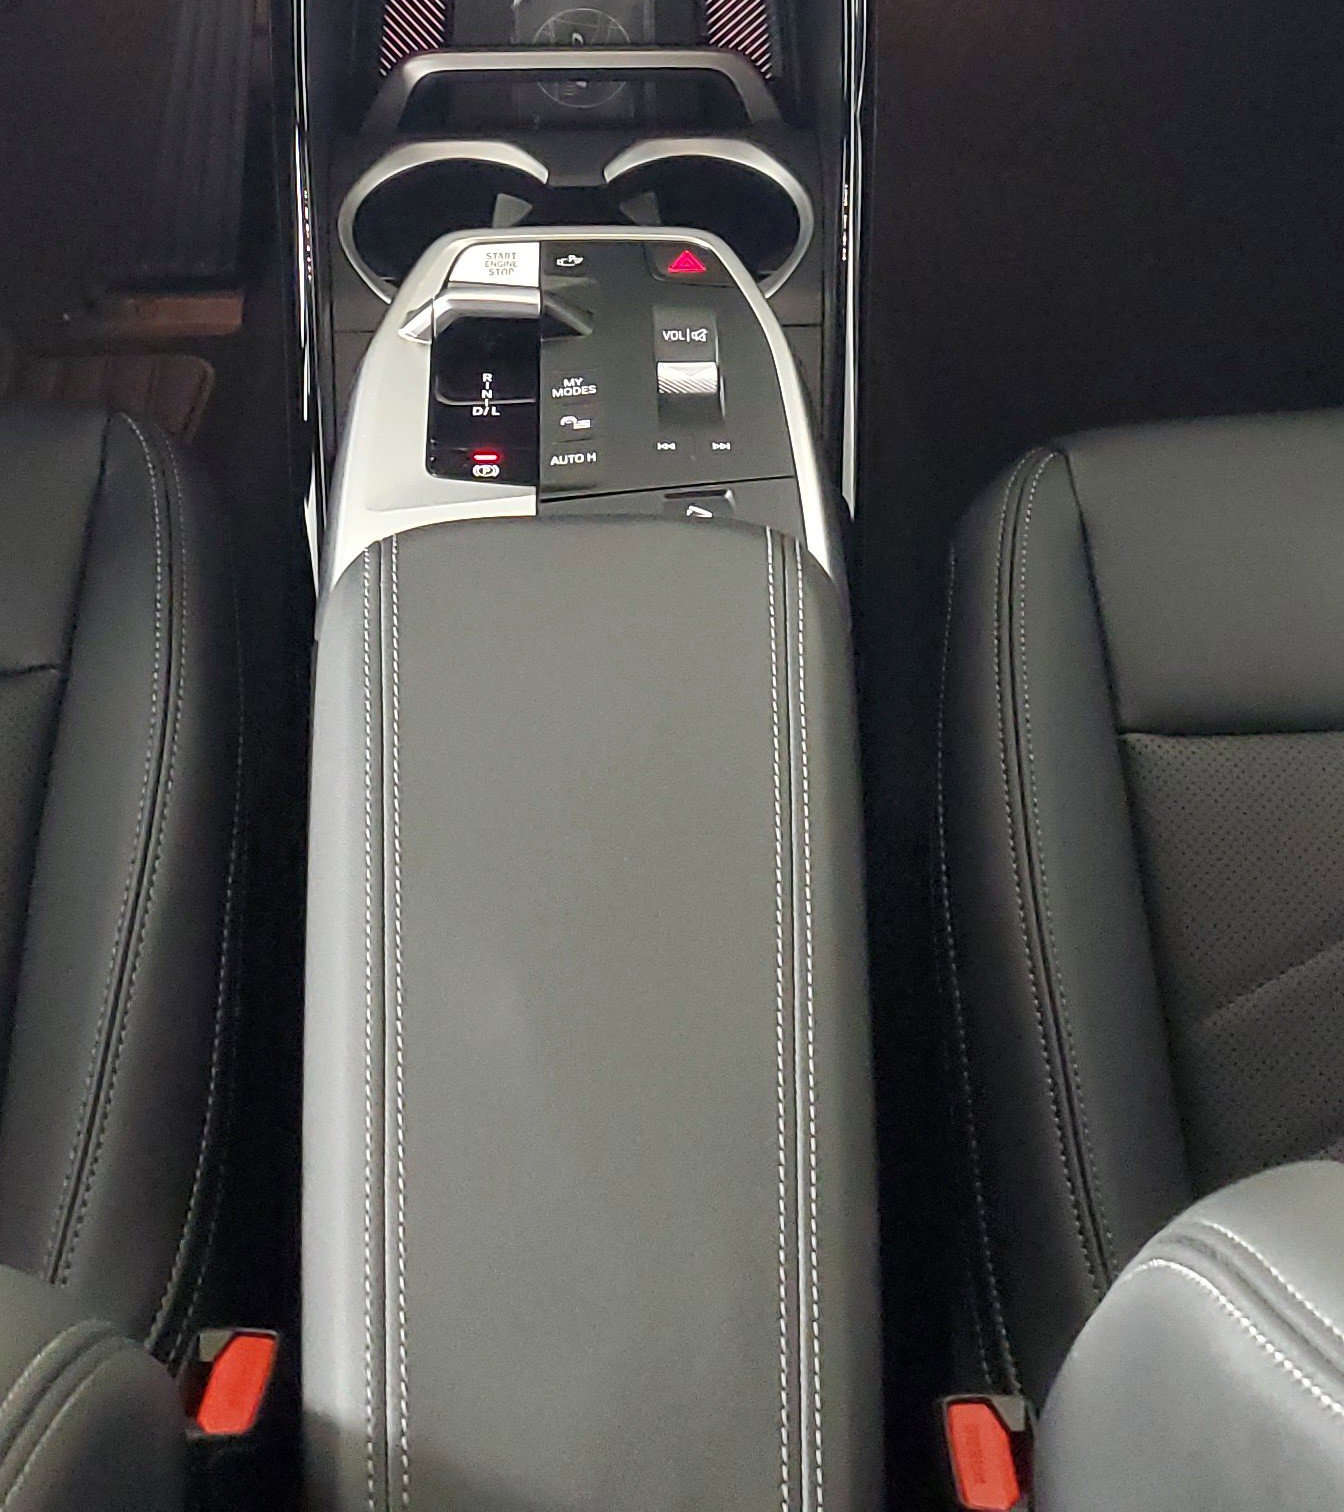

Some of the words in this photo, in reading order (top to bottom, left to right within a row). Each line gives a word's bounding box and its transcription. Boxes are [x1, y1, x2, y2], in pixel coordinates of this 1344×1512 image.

[486, 252, 517, 261] START
[484, 260, 518, 268] ENGINE
[488, 268, 515, 276] STOP
[662, 330, 686, 342] VOL
[482, 372, 493, 383] R
[563, 377, 585, 388] MY
[481, 389, 493, 399] N
[552, 385, 597, 398] MODES
[550, 453, 585, 466] AUTO
[586, 452, 598, 464] H
